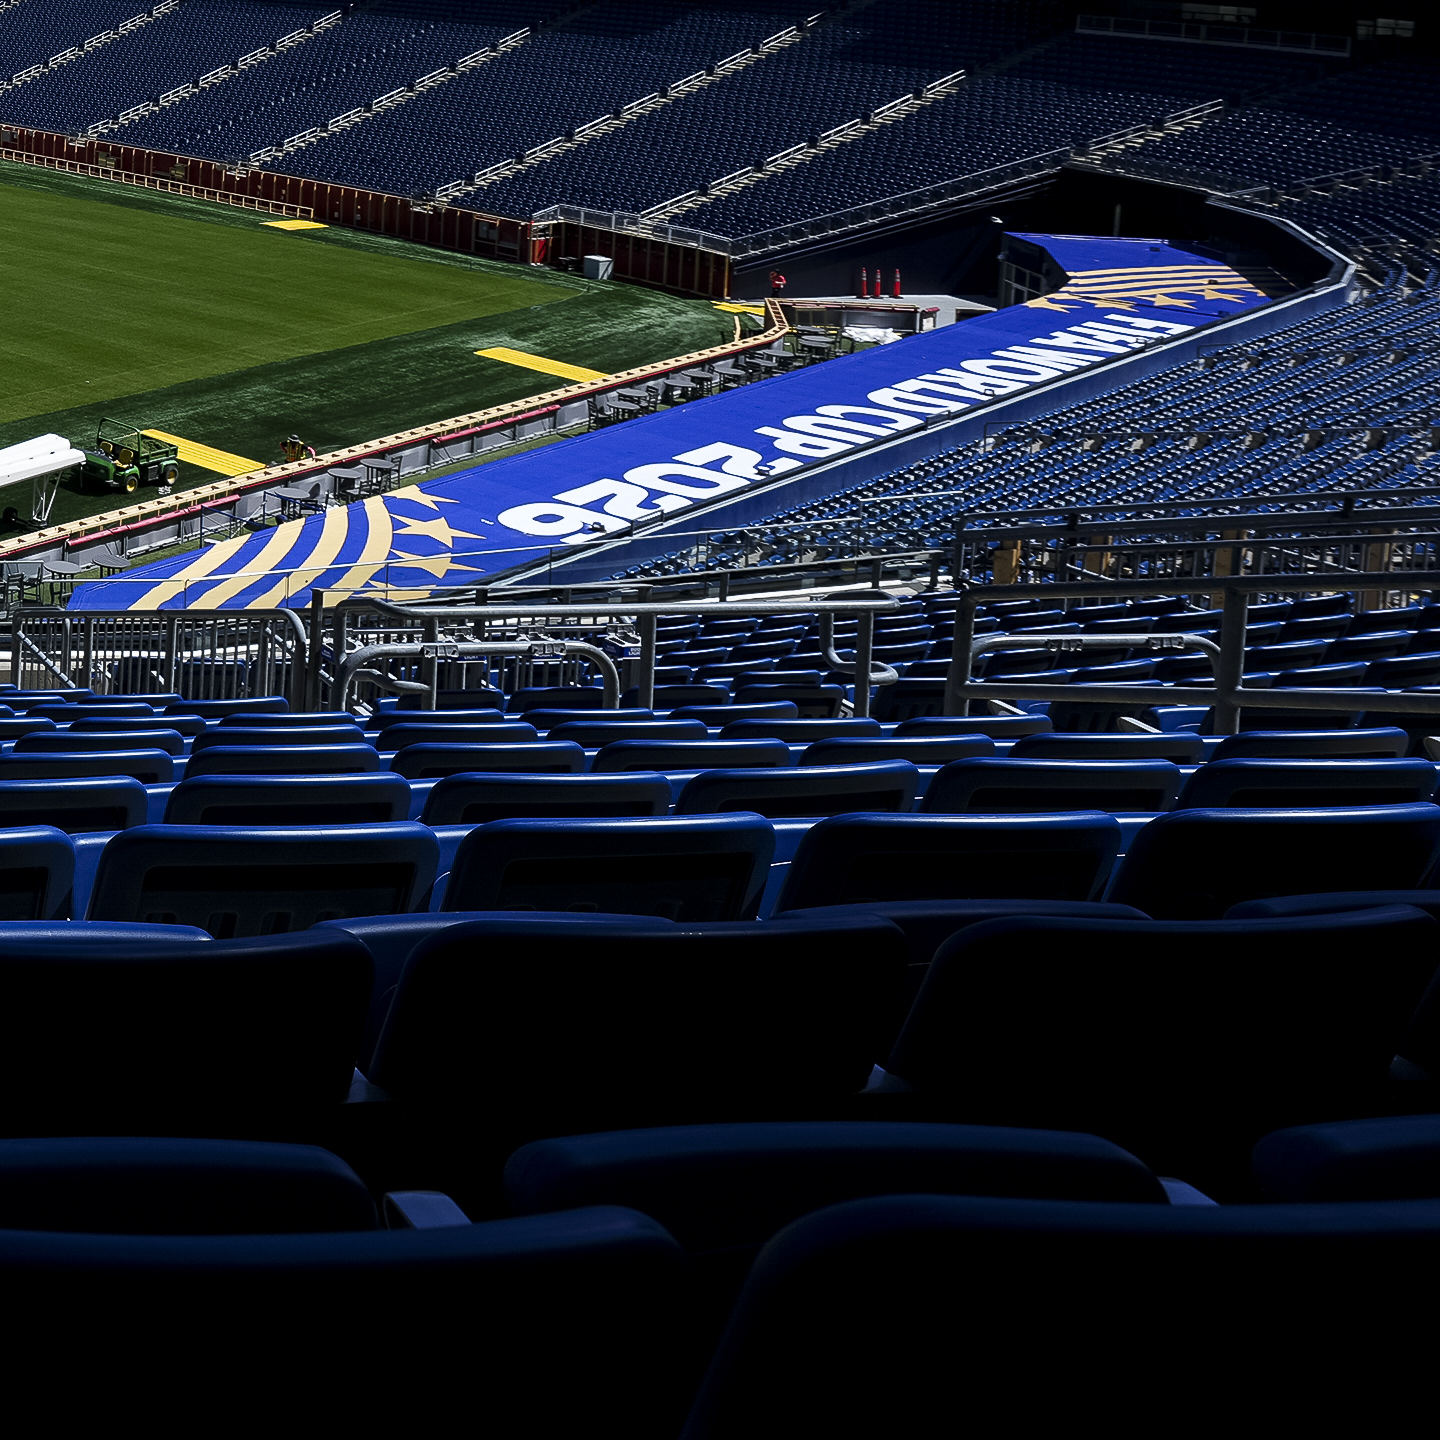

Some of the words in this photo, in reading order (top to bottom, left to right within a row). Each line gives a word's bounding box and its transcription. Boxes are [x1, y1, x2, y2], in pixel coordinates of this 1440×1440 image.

[1028, 313, 1196, 354] FIFA
[866, 345, 1108, 415] WORLD
[753, 404, 925, 458] CUP
[497, 441, 805, 544] 2026
